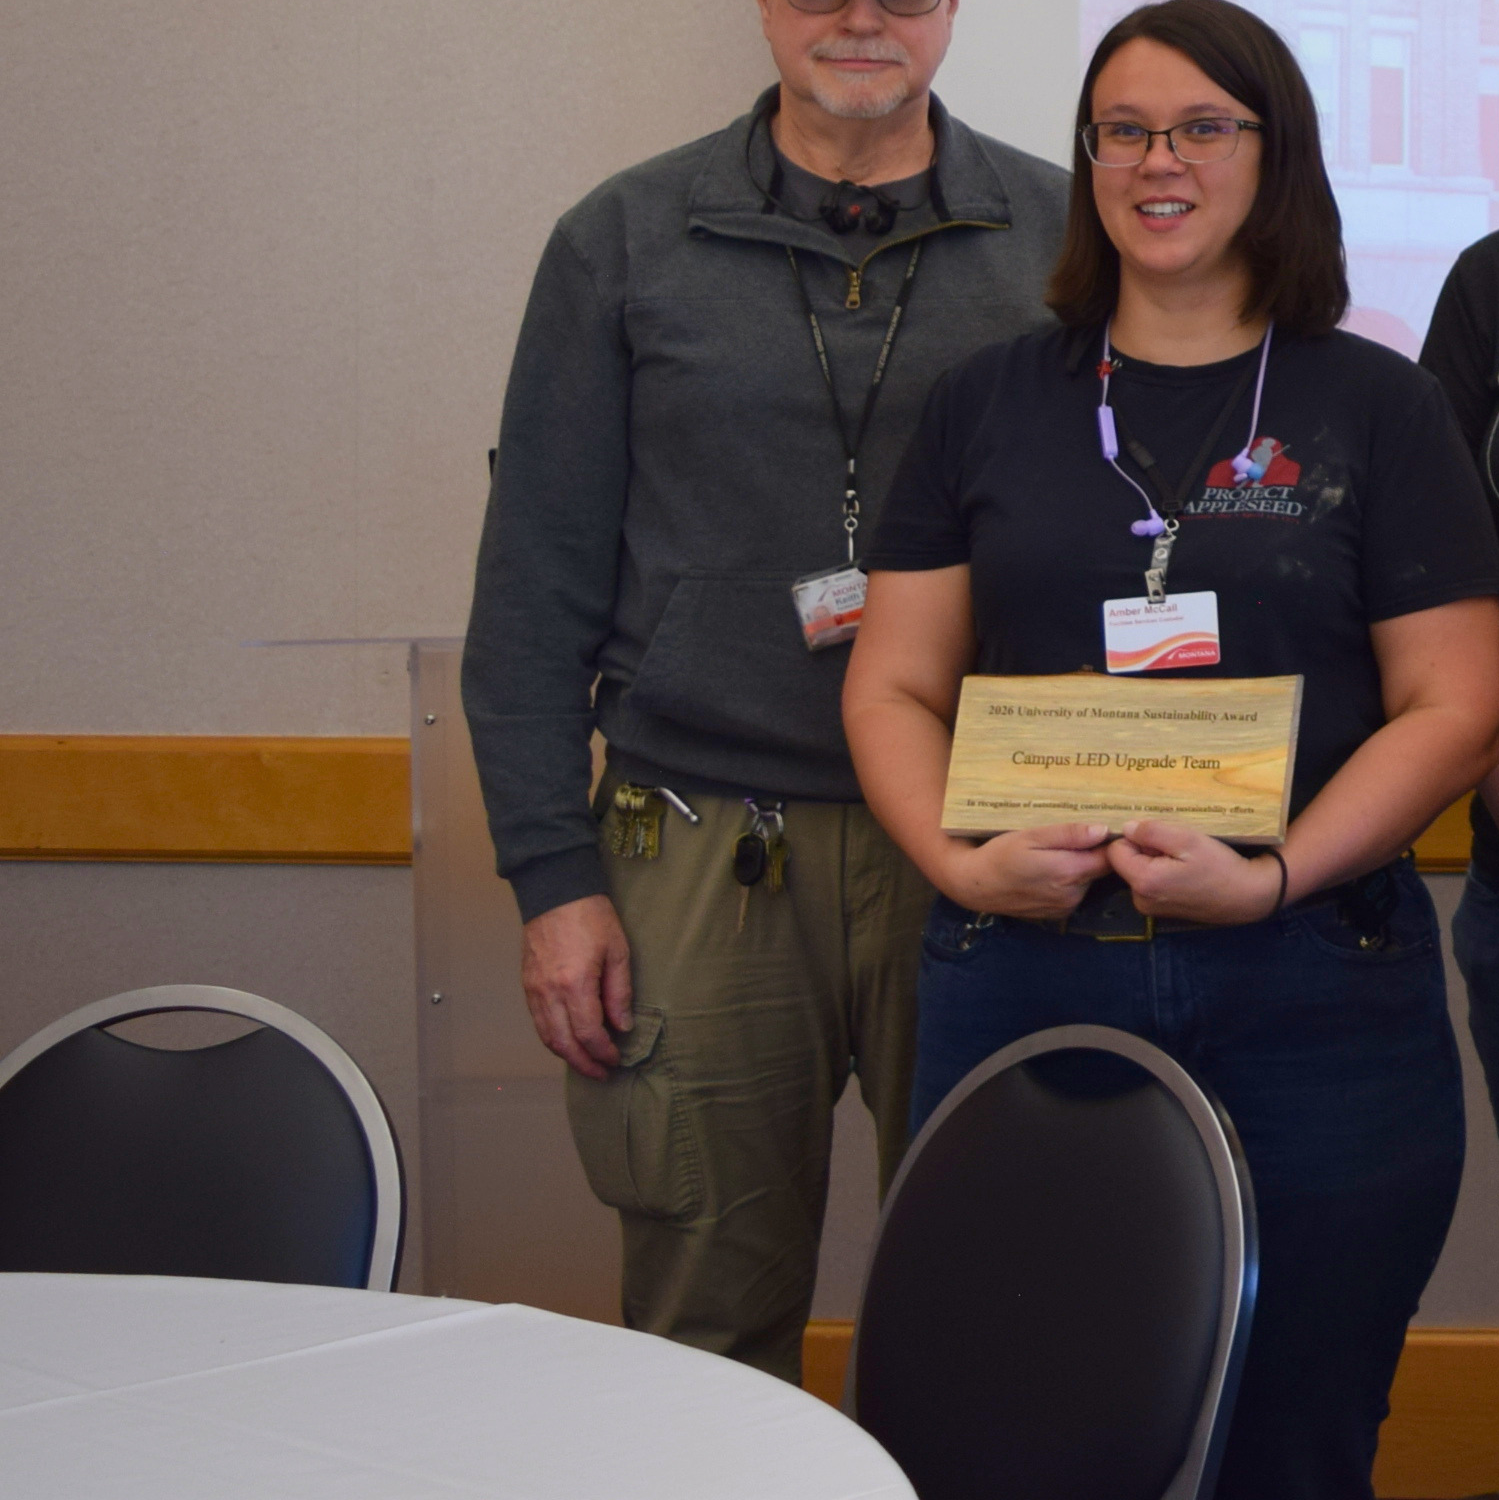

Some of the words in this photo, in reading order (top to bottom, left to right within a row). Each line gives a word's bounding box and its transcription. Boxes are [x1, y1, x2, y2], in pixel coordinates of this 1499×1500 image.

[1202, 486, 1294, 500] PROJECT
[1184, 500, 1303, 516] APPLESEED
[832, 582, 867, 597] MONT
[1109, 608, 1141, 617] Amber
[988, 705, 1014, 715] 2026
[1018, 706, 1073, 719] University
[1076, 707, 1089, 717] of
[1090, 708, 1140, 719] Montana
[1143, 708, 1217, 723] Sustainability
[1221, 711, 1258, 722] Award
[1011, 751, 1070, 769] Campus
[1075, 753, 1110, 767] LED
[1115, 753, 1176, 771] Upgrade
[1181, 755, 1220, 769] Team
